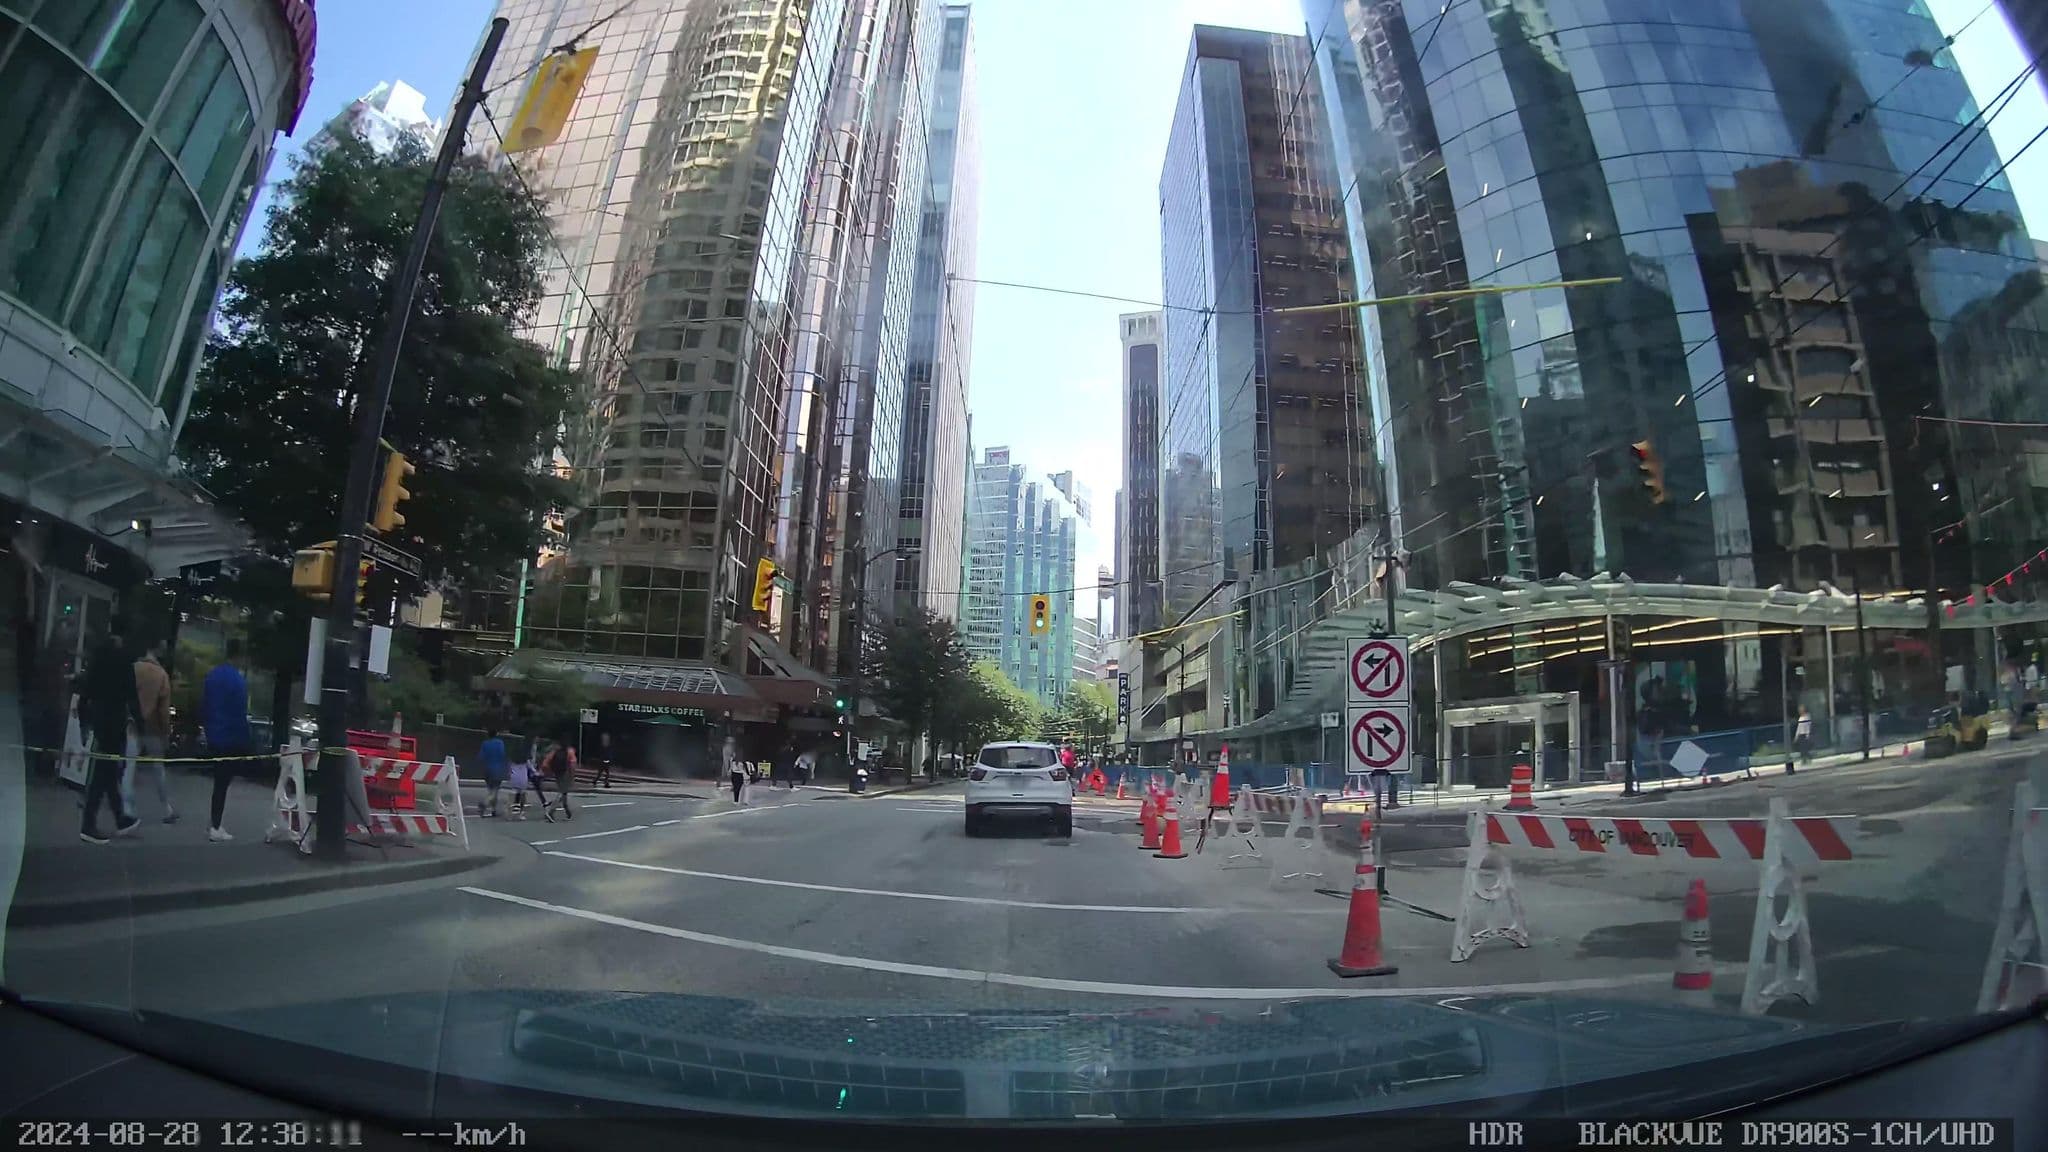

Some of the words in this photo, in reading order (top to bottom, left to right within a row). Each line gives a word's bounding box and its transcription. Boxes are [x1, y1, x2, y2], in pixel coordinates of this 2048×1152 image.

[618, 703, 670, 714] STARBUCKS
[671, 707, 705, 717] COFFEE
[1599, 829, 1615, 845] OF
